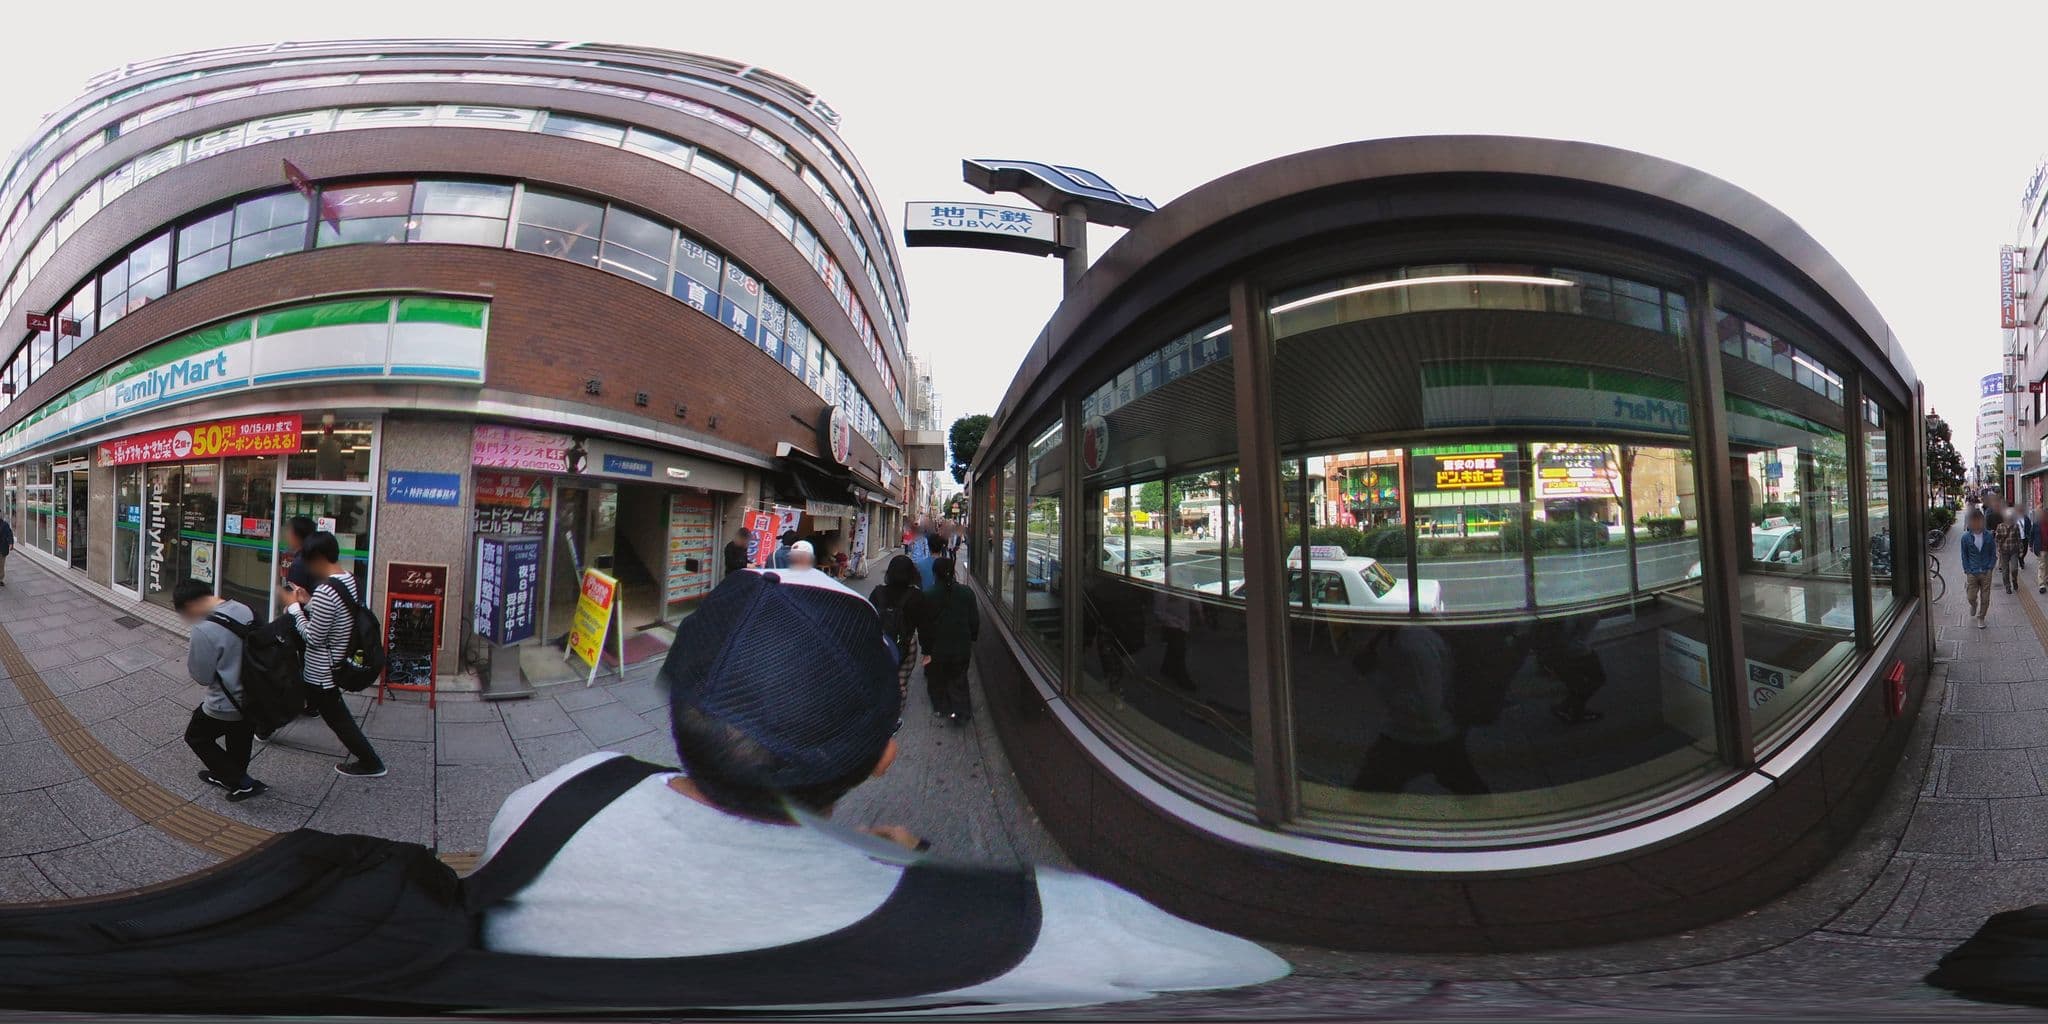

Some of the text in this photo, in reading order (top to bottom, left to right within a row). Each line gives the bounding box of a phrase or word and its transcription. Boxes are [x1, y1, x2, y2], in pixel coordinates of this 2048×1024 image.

[931, 206, 1033, 225] 地下鉄
[933, 218, 1032, 234] SUBWAY
[114, 350, 227, 407] FamilyMart
[221, 434, 296, 452] クーポンもらえる!
[475, 442, 544, 459] 専門スタジオ
[149, 477, 166, 592] amilyMart
[516, 565, 529, 627] 夜8時まで
[505, 592, 518, 641] 受付中!!
